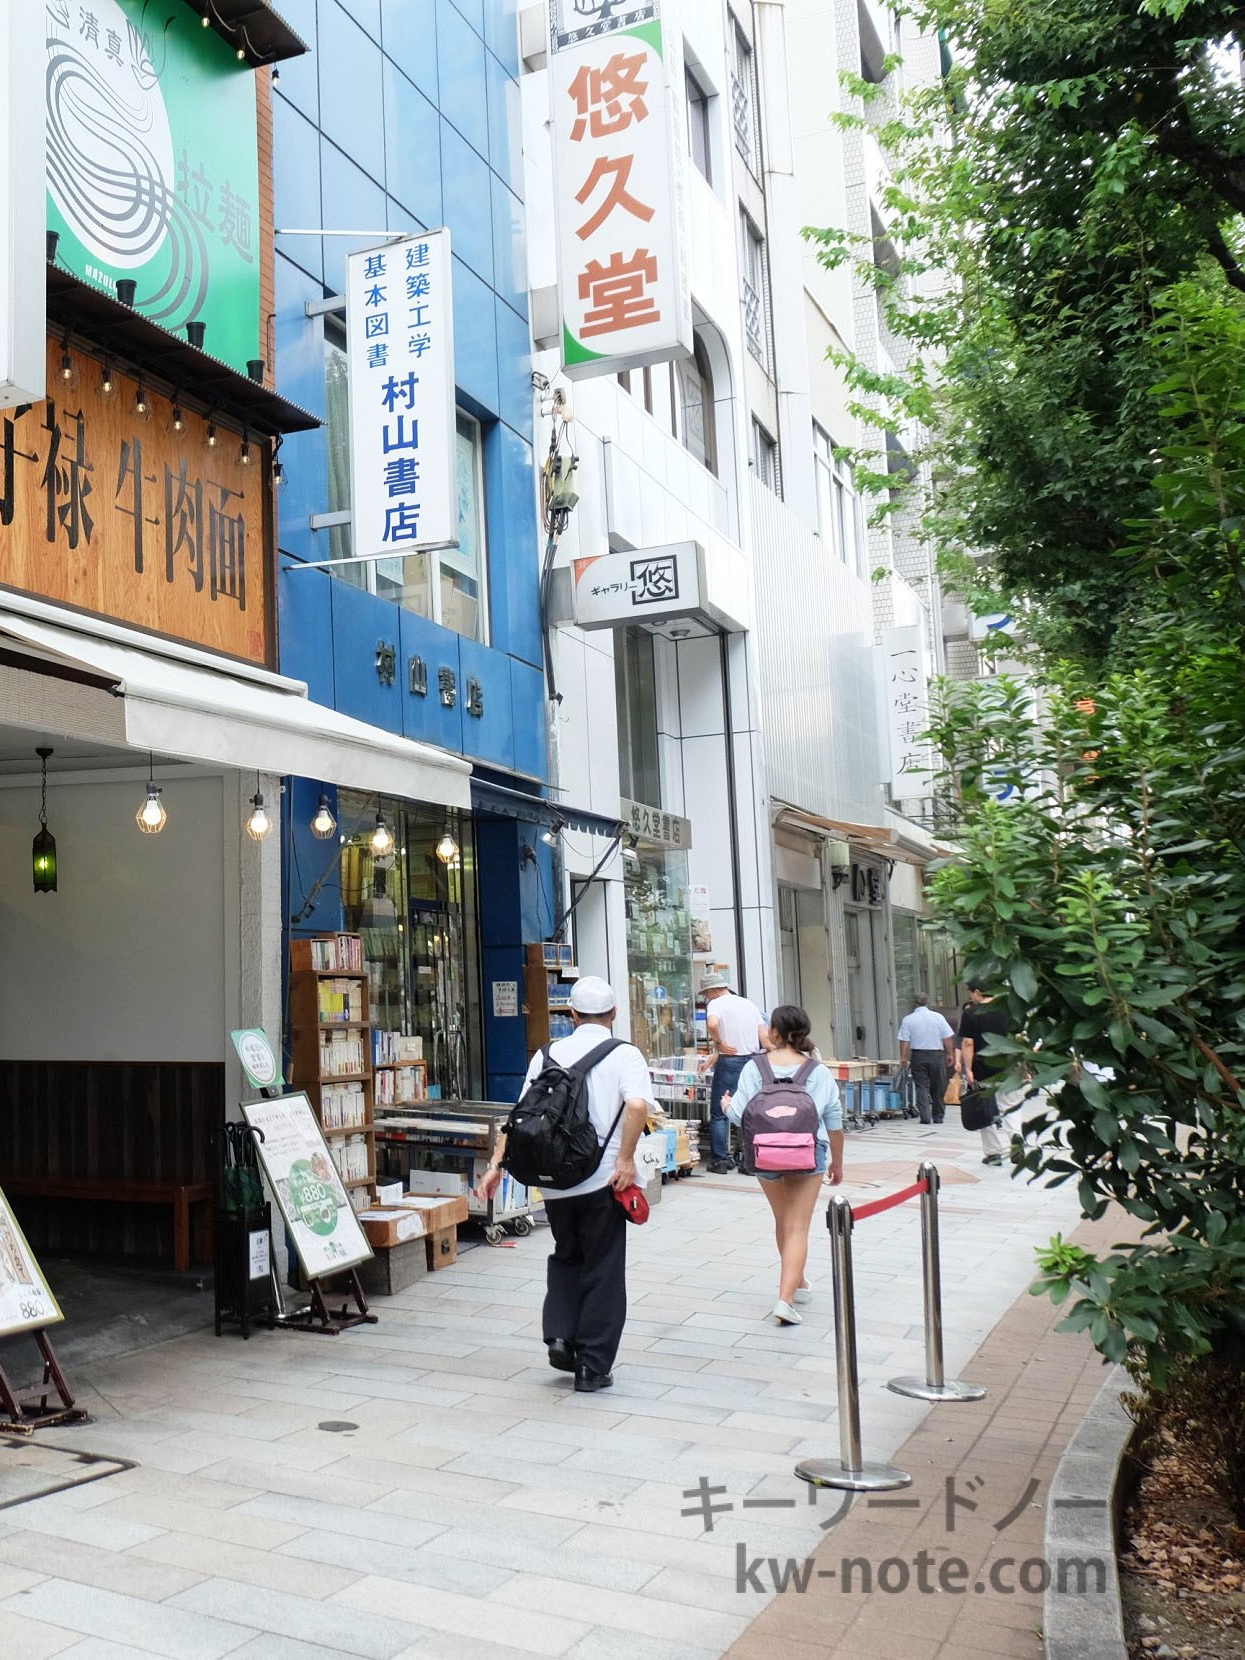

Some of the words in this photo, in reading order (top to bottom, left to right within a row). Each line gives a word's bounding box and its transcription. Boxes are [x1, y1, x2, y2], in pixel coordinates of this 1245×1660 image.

[78, 6, 125, 67] 清真
[567, 52, 661, 339] 悠久堂
[363, 253, 389, 370] 基本図書
[381, 371, 421, 543] 村山書店
[115, 437, 245, 611] 牛肉面
[591, 583, 638, 596] ギャラリー
[637, 563, 674, 599] 悠
[890, 648, 921, 776] 一心堂書店
[631, 804, 681, 844] 悠久堂書店
[19, 1300, 45, 1320] 880
